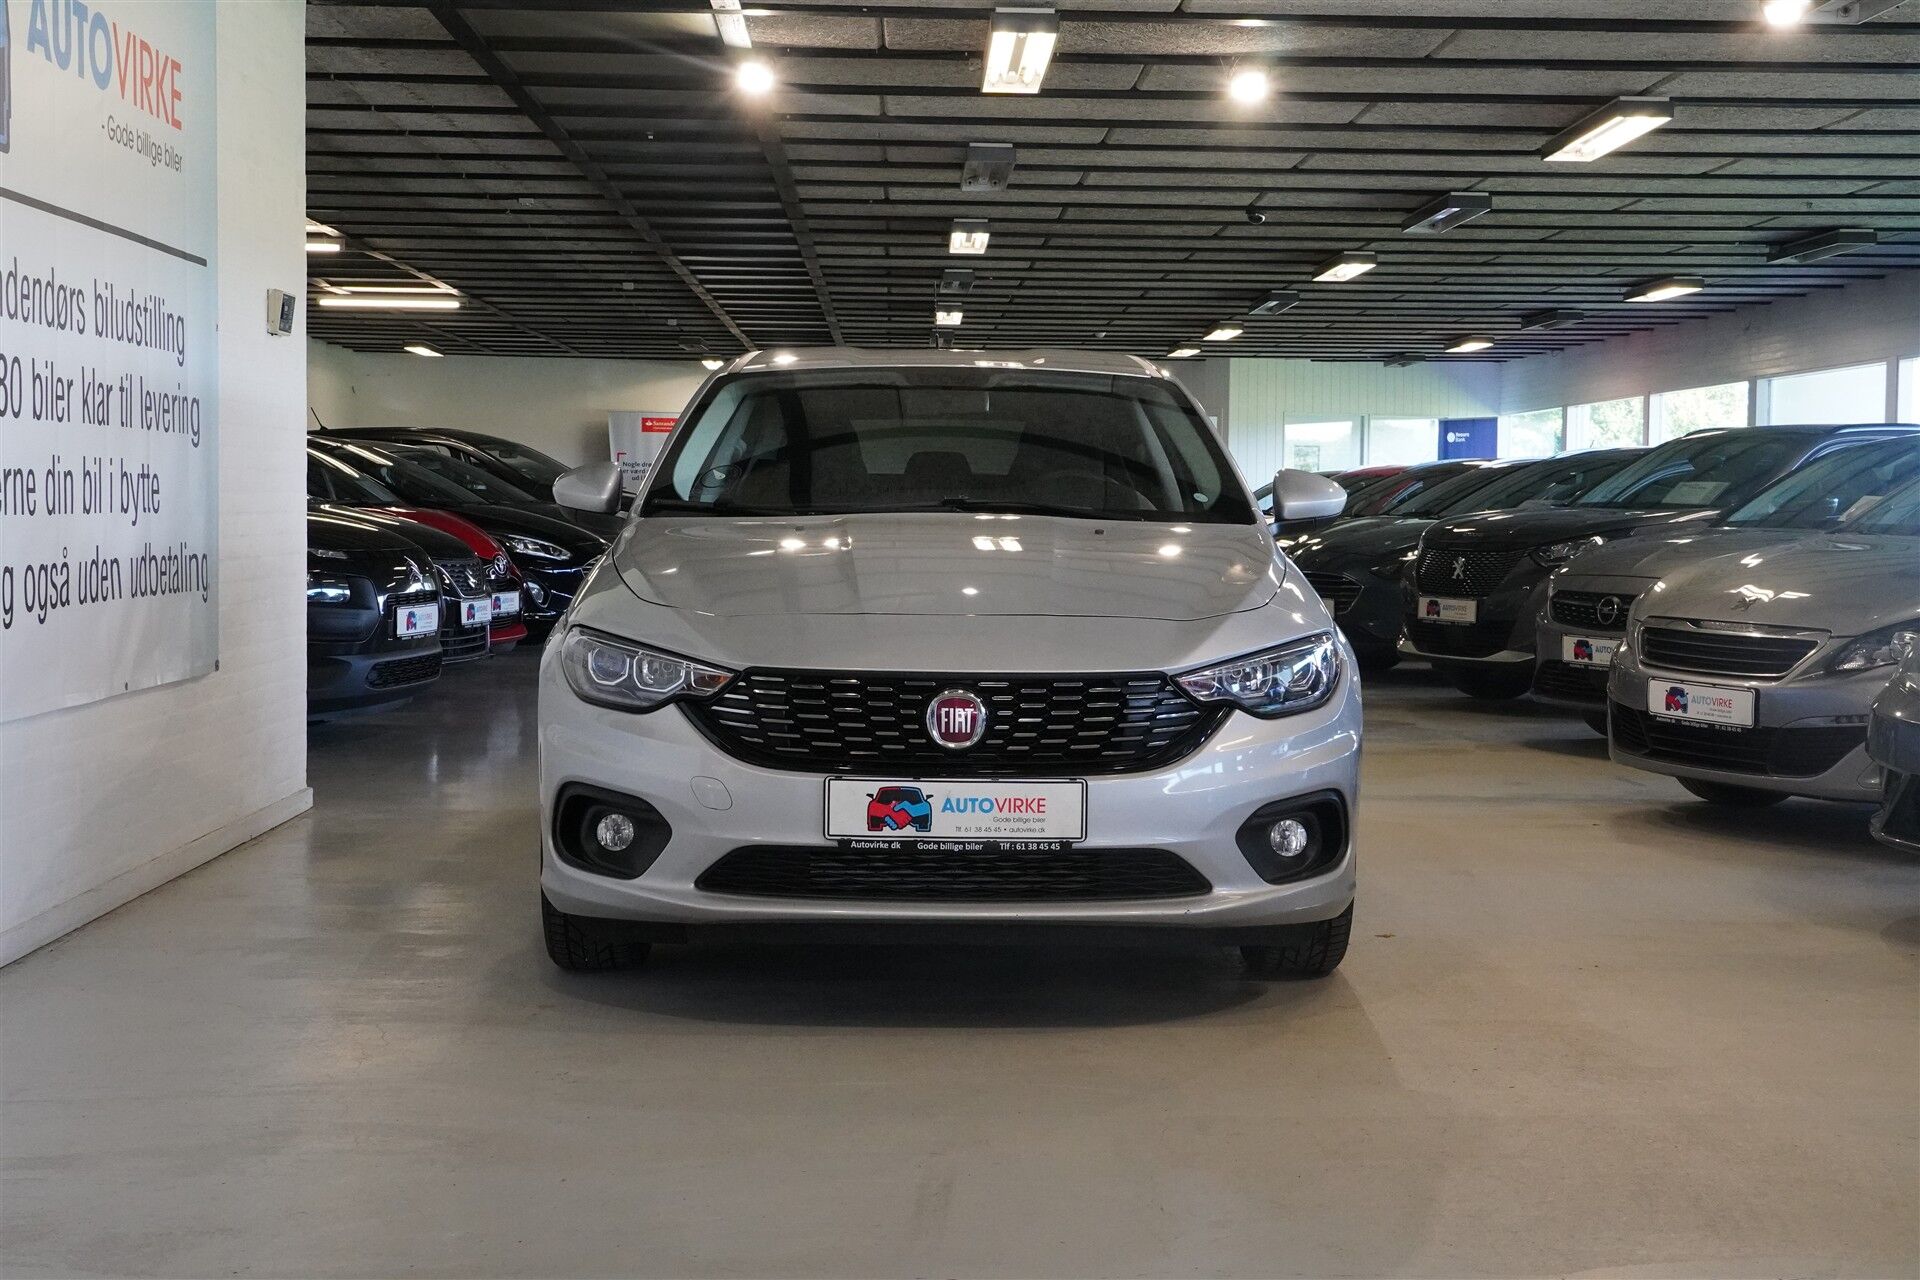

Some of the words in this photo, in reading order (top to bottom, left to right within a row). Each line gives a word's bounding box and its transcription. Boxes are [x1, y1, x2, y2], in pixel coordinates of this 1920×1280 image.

[27, 0, 182, 131] AUTOVIRKE
[107, 114, 134, 150] Gode
[136, 128, 162, 167] billige
[165, 142, 182, 174] biler
[0, 256, 86, 335] dendørs
[94, 278, 185, 367] biludstilling
[32, 358, 73, 423] biler
[82, 366, 113, 426] klar
[119, 373, 132, 428] til
[140, 375, 200, 448] levering
[0, 467, 36, 516] rne
[46, 454, 74, 516] din
[82, 456, 102, 514] bil
[110, 458, 113, 514] i
[120, 458, 160, 526] bytte
[24, 547, 70, 625] også
[78, 545, 122, 605] uden
[130, 541, 208, 603] udbetaling
[941, 707, 975, 734] FIAT
[1691, 695, 1732, 708] AUTOVIRKE
[941, 798, 1046, 814] AUTOVIRKE
[850, 840, 888, 848] Autovirke
[917, 842, 938, 850] Gode
[940, 842, 963, 852] billige
[1016, 842, 1026, 850] 61
[1028, 842, 1038, 850] 38
[1039, 842, 1049, 850] 45
[1050, 842, 1060, 850] 45
